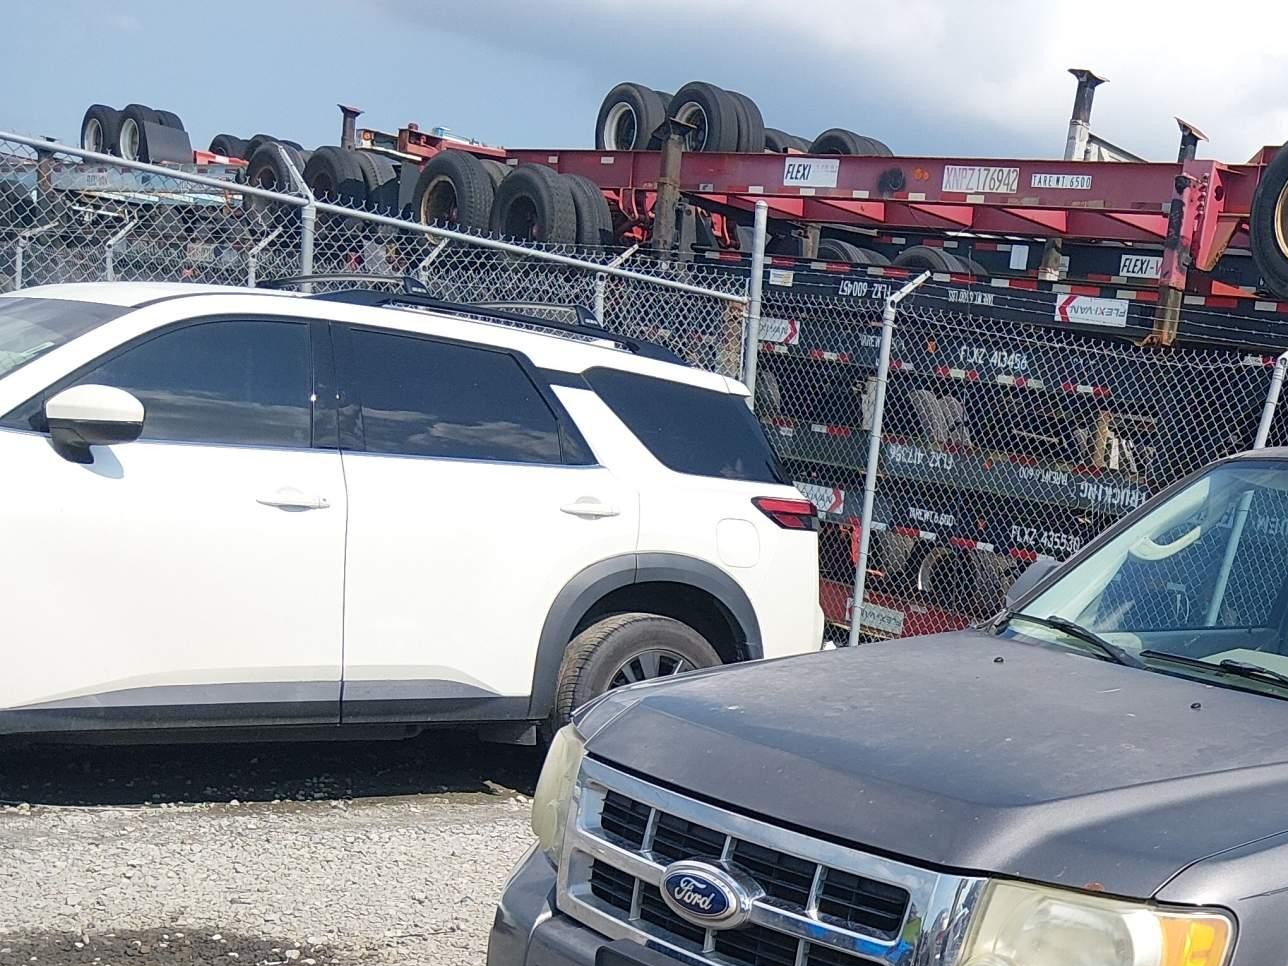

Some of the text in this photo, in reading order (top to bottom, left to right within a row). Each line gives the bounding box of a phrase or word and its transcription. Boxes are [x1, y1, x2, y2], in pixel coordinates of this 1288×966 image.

[785, 163, 812, 181] FLEXI
[1033, 175, 1053, 187] TARE
[1069, 176, 1091, 188] 6500
[1121, 257, 1162, 276] FLEXI-V
[960, 345, 1028, 371] FLXZ 413456
[674, 877, 715, 910] Ford
